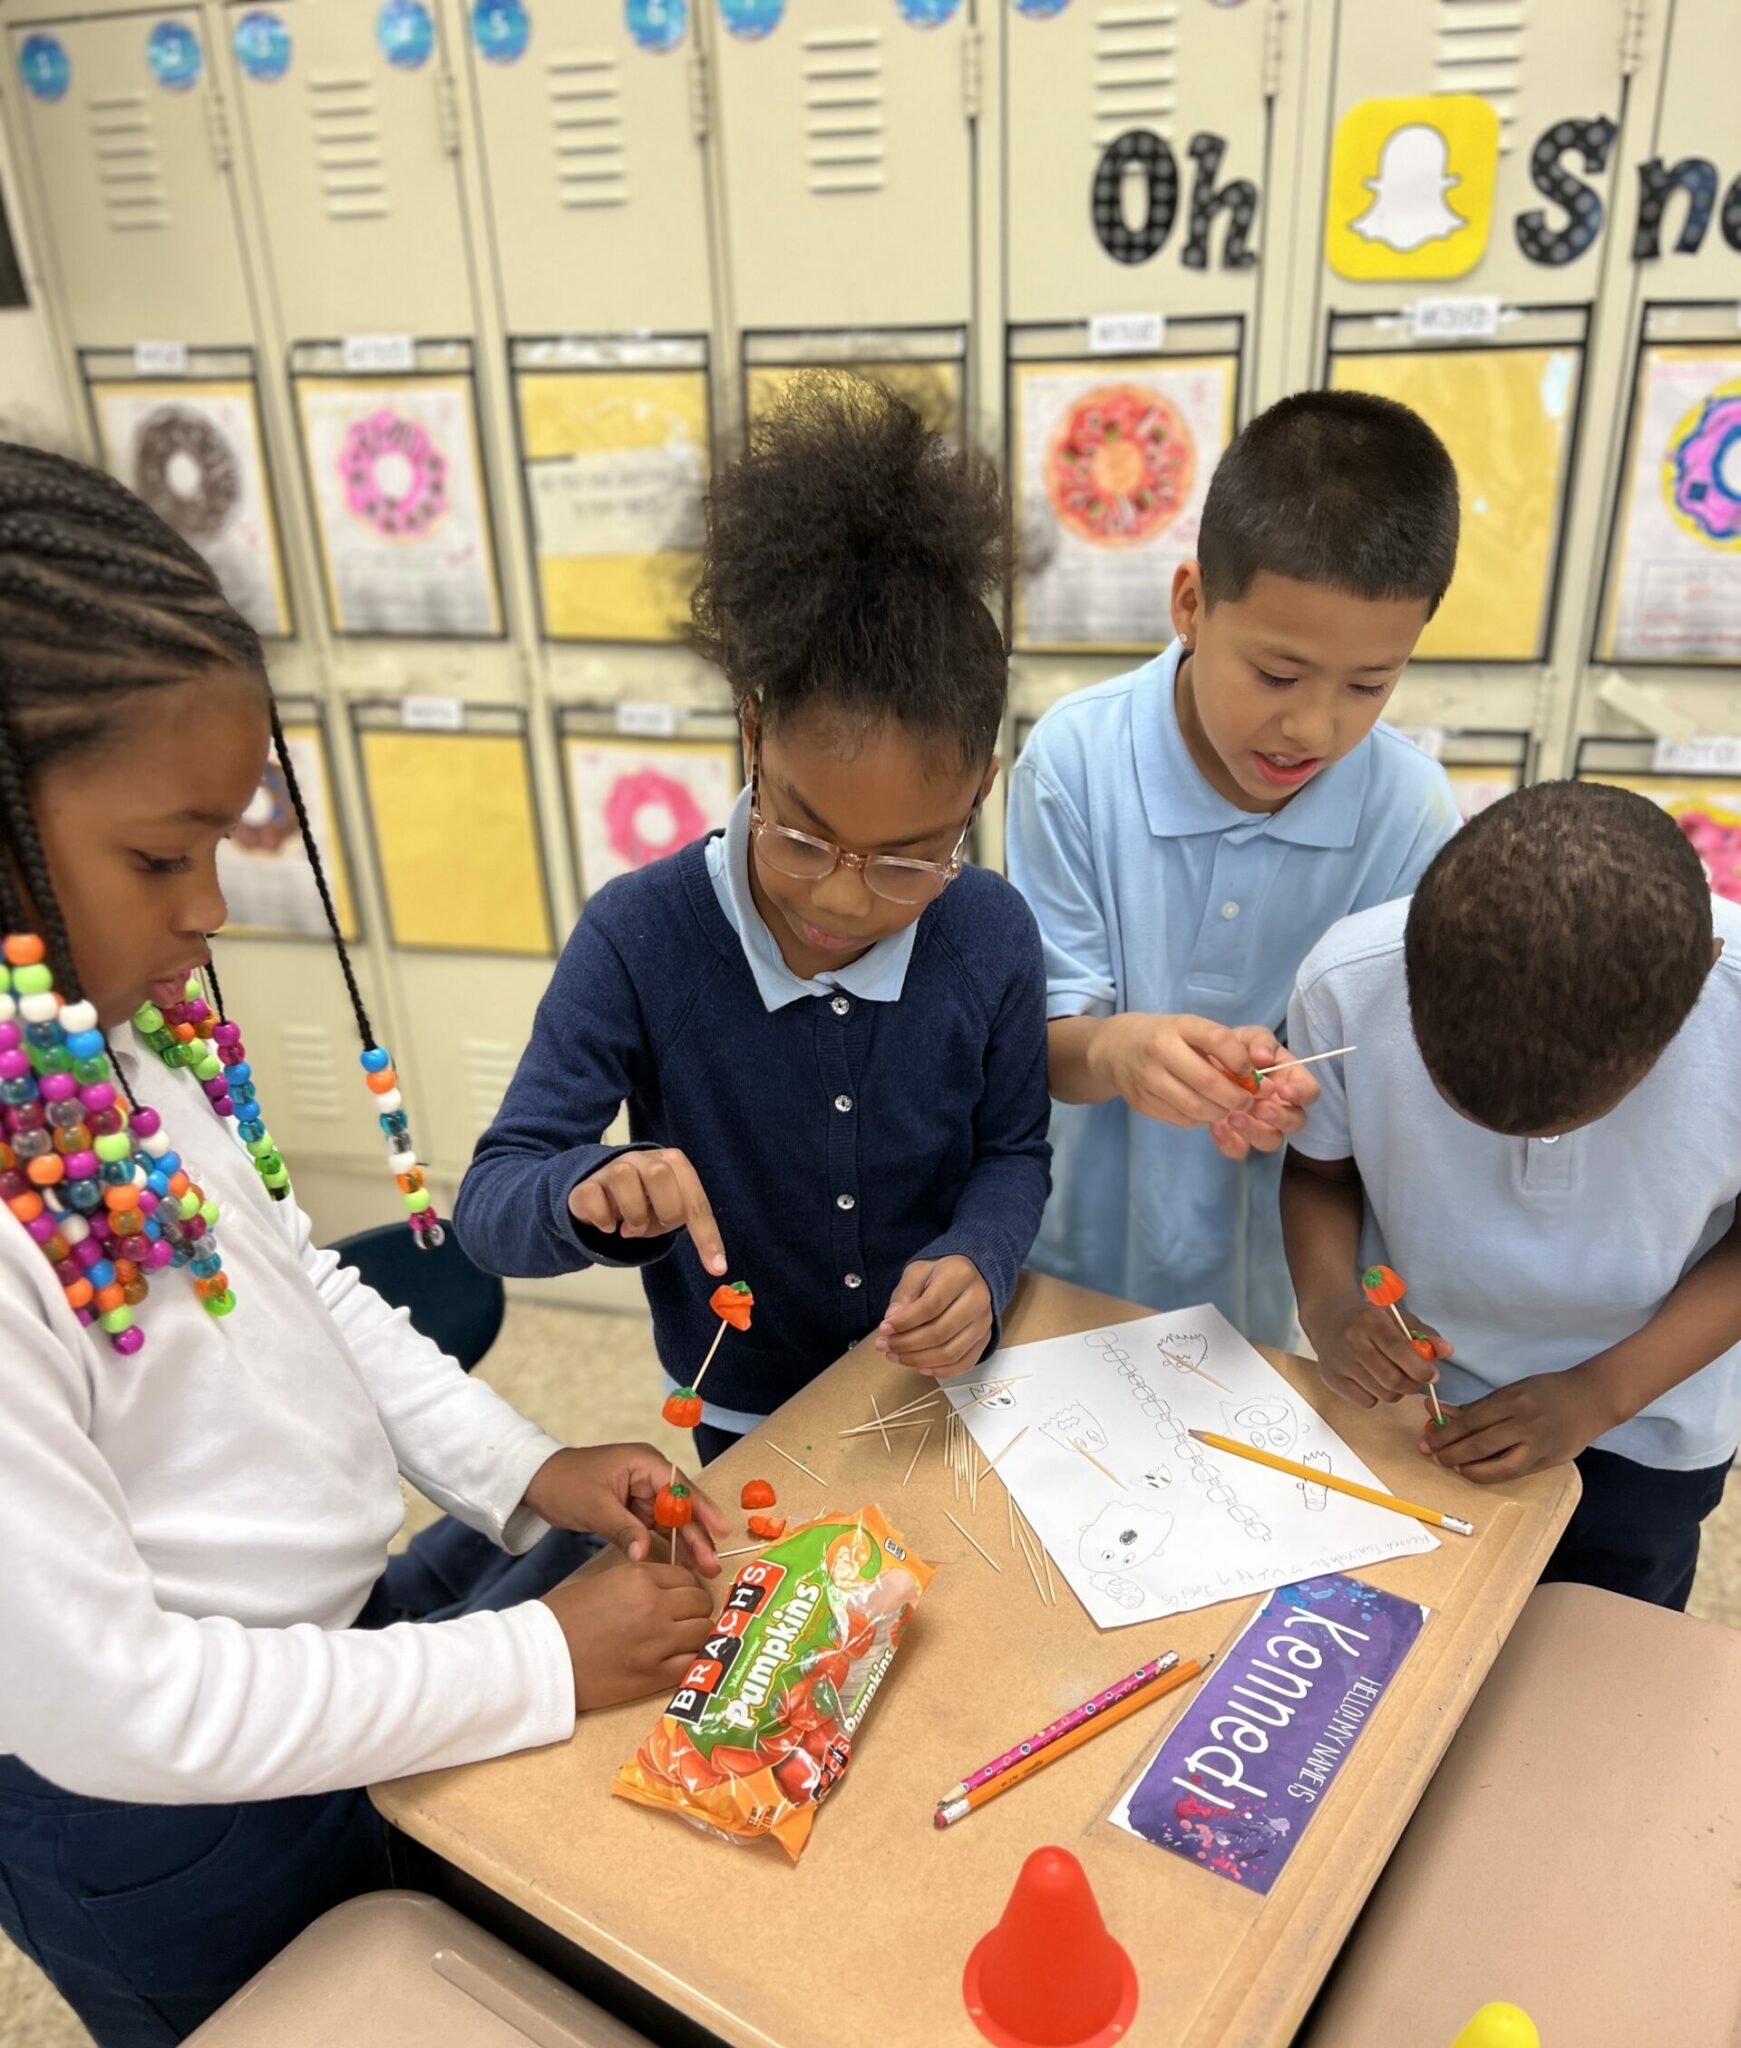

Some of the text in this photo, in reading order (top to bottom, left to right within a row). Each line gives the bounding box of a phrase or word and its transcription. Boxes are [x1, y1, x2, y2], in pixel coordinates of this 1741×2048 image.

[1092, 128, 1258, 270] Oh
[670, 1565, 768, 1711] BRACH'S
[726, 1582, 821, 1728] Pumpkins
[1287, 1676, 1382, 1803] HELLO! MY NAME IS
